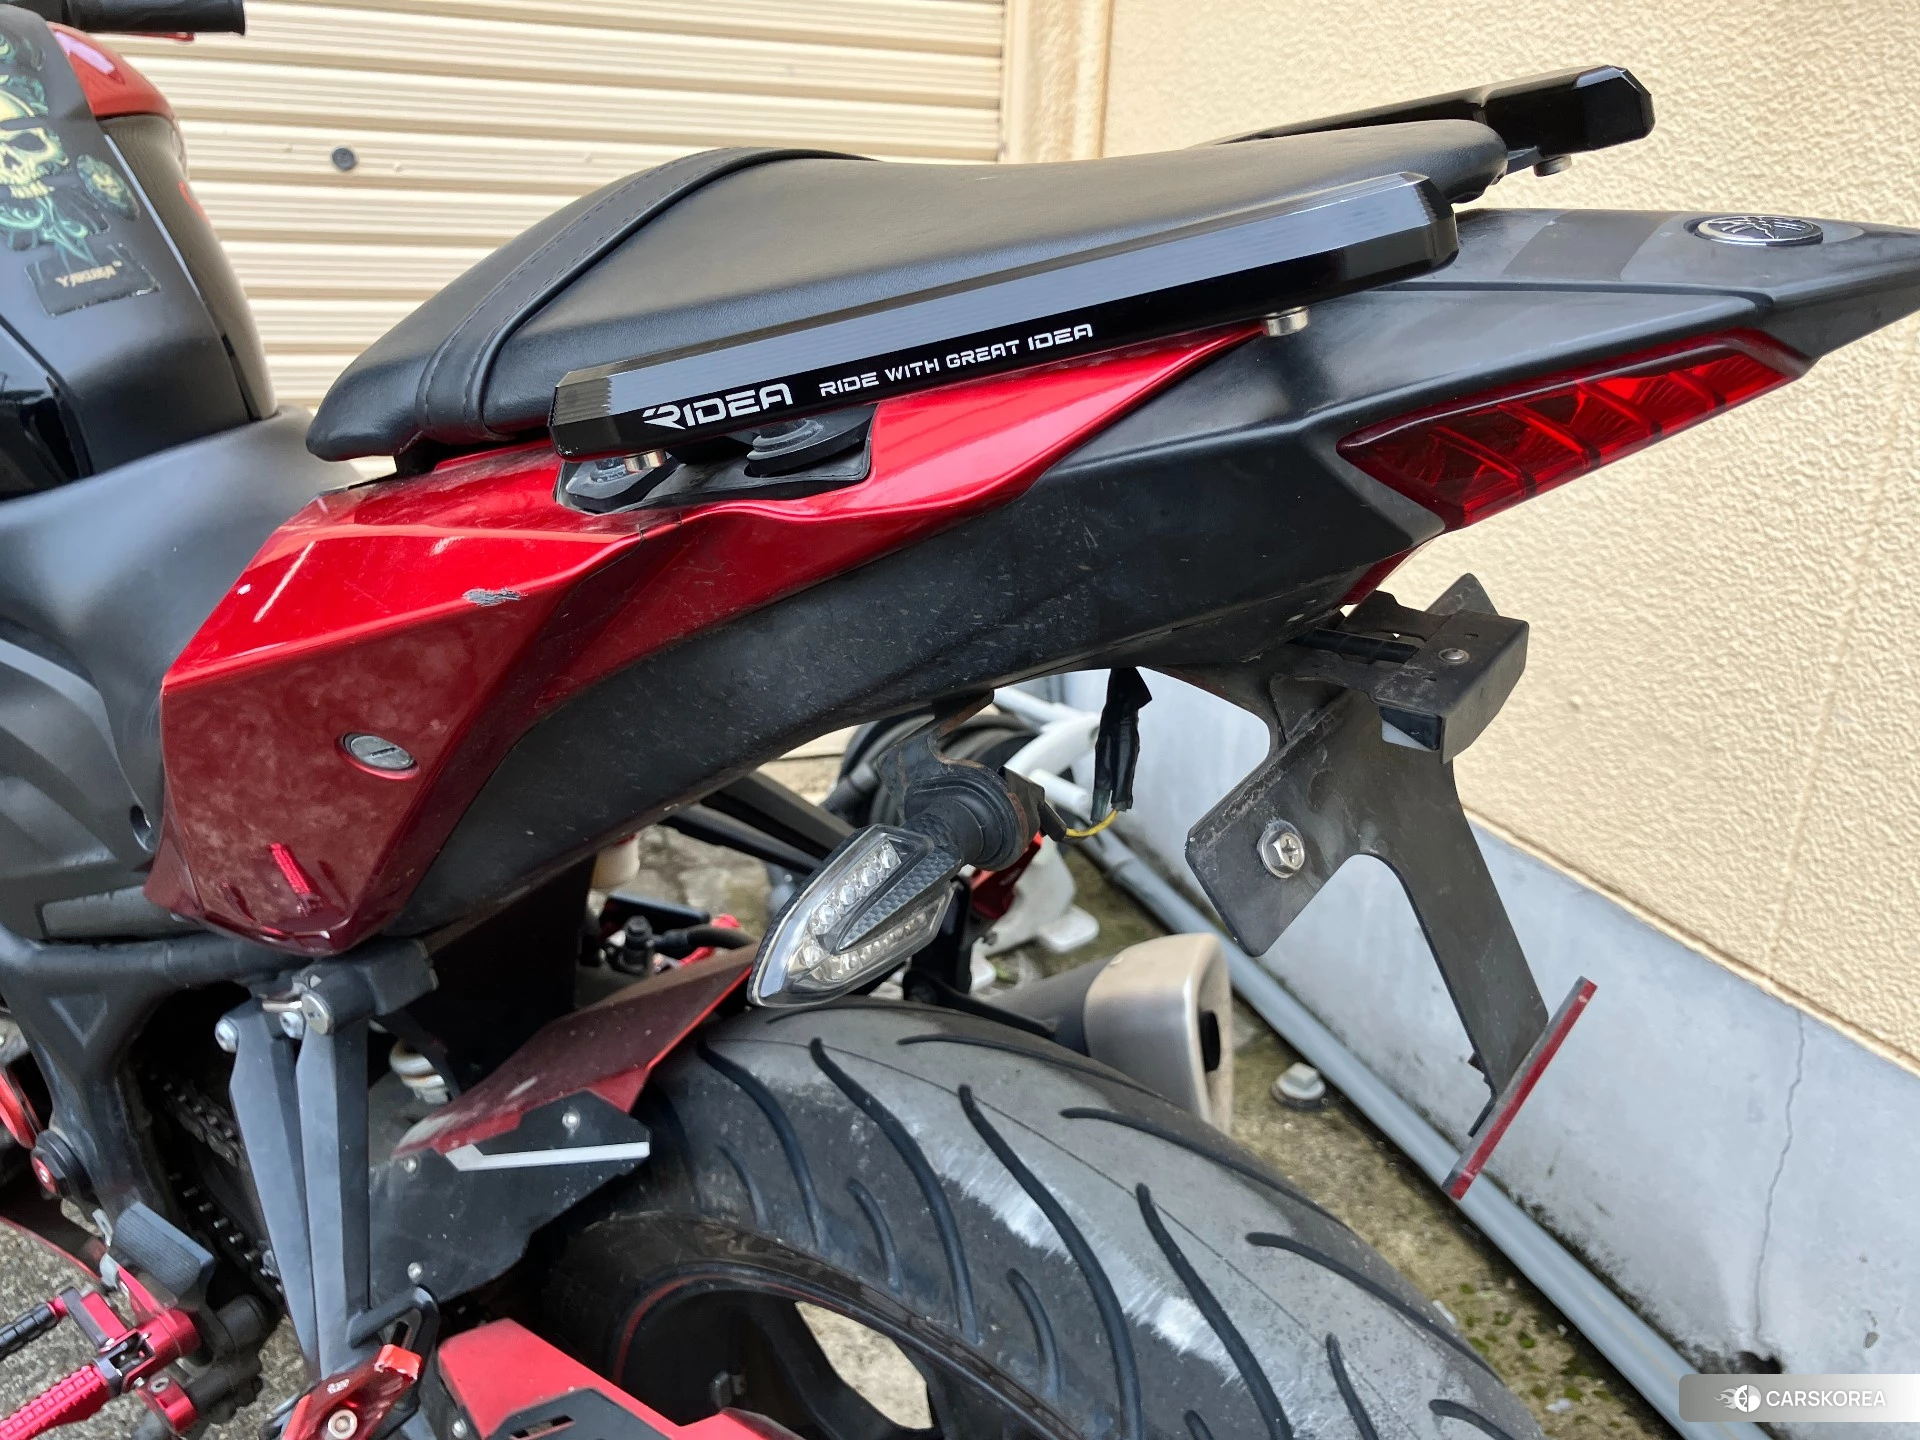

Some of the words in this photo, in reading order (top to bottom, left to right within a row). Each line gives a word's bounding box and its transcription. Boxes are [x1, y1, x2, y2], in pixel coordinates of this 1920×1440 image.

[818, 371, 880, 397] RIDE
[884, 358, 940, 382] WITH
[945, 339, 1020, 369] GREAT
[1027, 323, 1094, 351] IDEA
[641, 382, 794, 430] RIDEA
